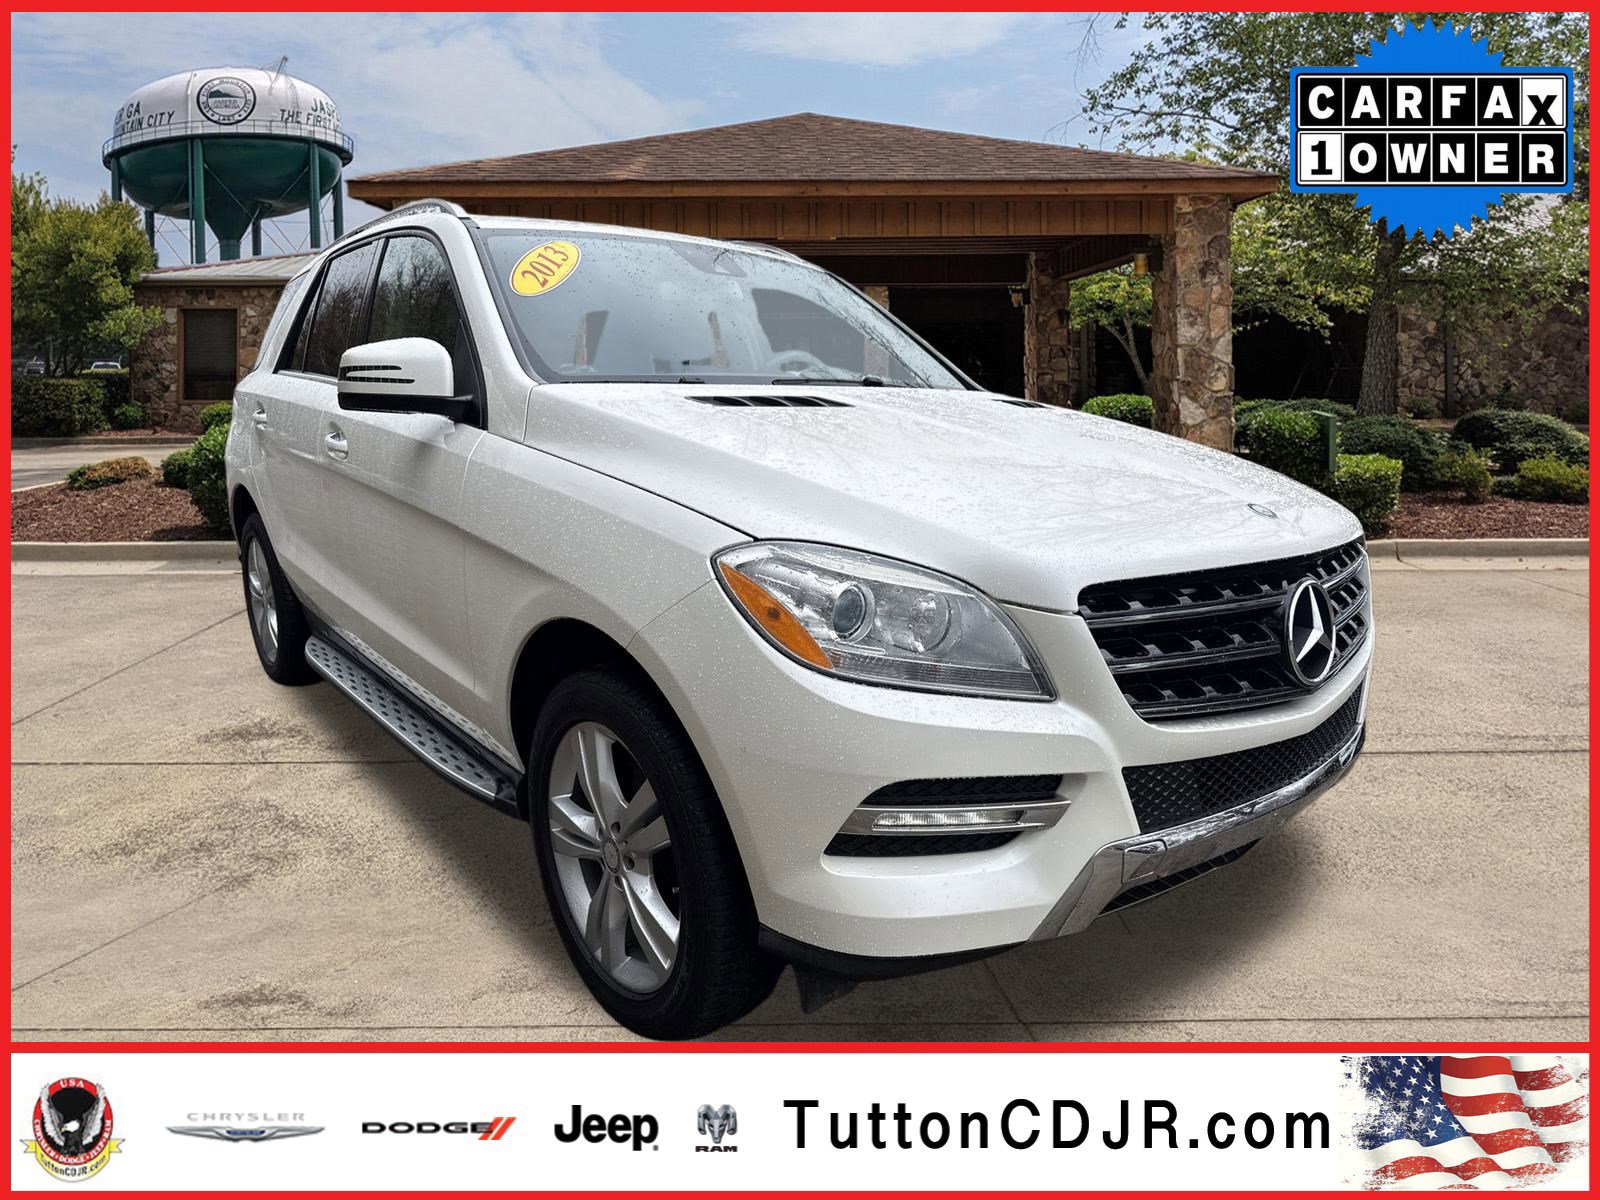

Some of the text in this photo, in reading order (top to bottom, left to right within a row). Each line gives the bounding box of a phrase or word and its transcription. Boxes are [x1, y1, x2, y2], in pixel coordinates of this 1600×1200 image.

[127, 101, 140, 119] GA
[147, 110, 175, 127] CITY
[280, 109, 302, 124] THE
[521, 246, 569, 288] 2013
